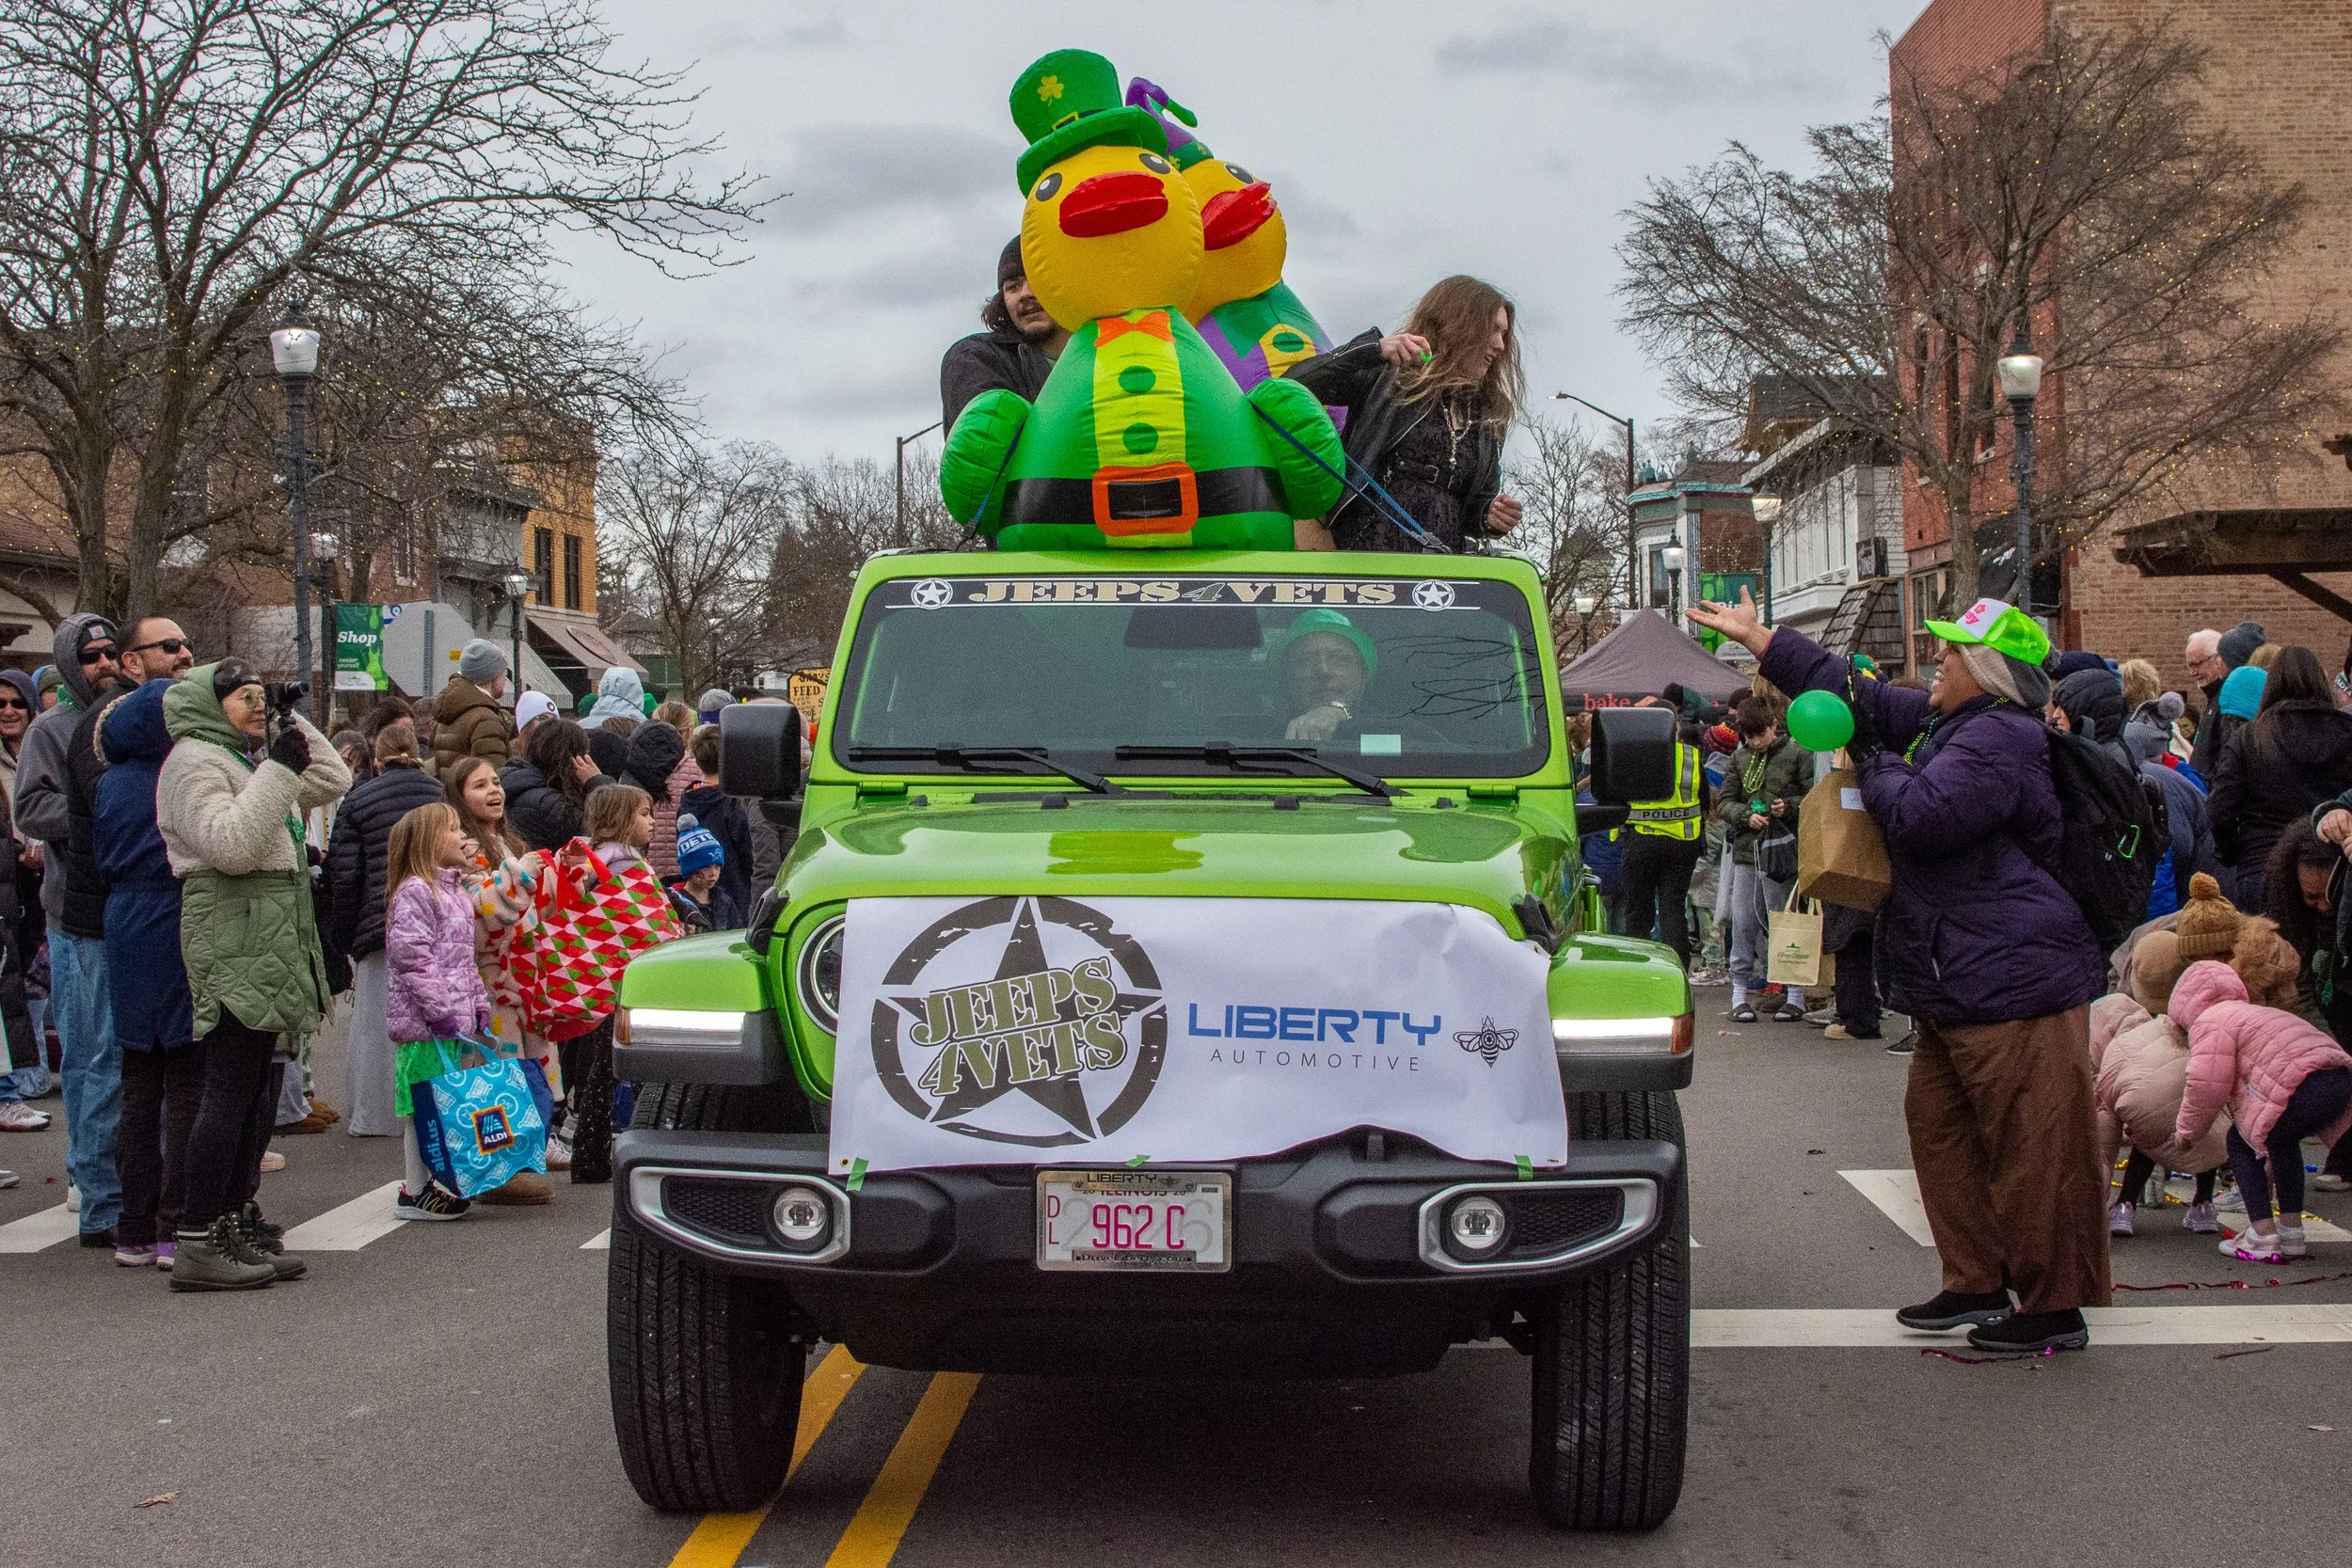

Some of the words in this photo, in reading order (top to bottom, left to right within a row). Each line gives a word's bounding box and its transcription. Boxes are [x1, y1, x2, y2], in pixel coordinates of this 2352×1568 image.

[968, 581, 1397, 604] JEEPS4VETS
[337, 631, 377, 647] Shop
[793, 685, 821, 696] FEED
[1583, 692, 1631, 711] bake
[1643, 810, 1690, 819] POLICE
[910, 957, 1117, 1046] JEEPS
[1188, 1003, 1441, 1046] LIBERTY
[919, 1011, 1127, 1097] 4VETS
[1211, 1049, 1419, 1071] AUTOMOTIVE
[427, 1118, 446, 1172] aldi.us
[484, 1132, 508, 1145] ALDI
[1087, 1174, 1157, 1183] LIBERTY
[1092, 1204, 1153, 1249] 962
[1166, 1204, 1186, 1250] C
